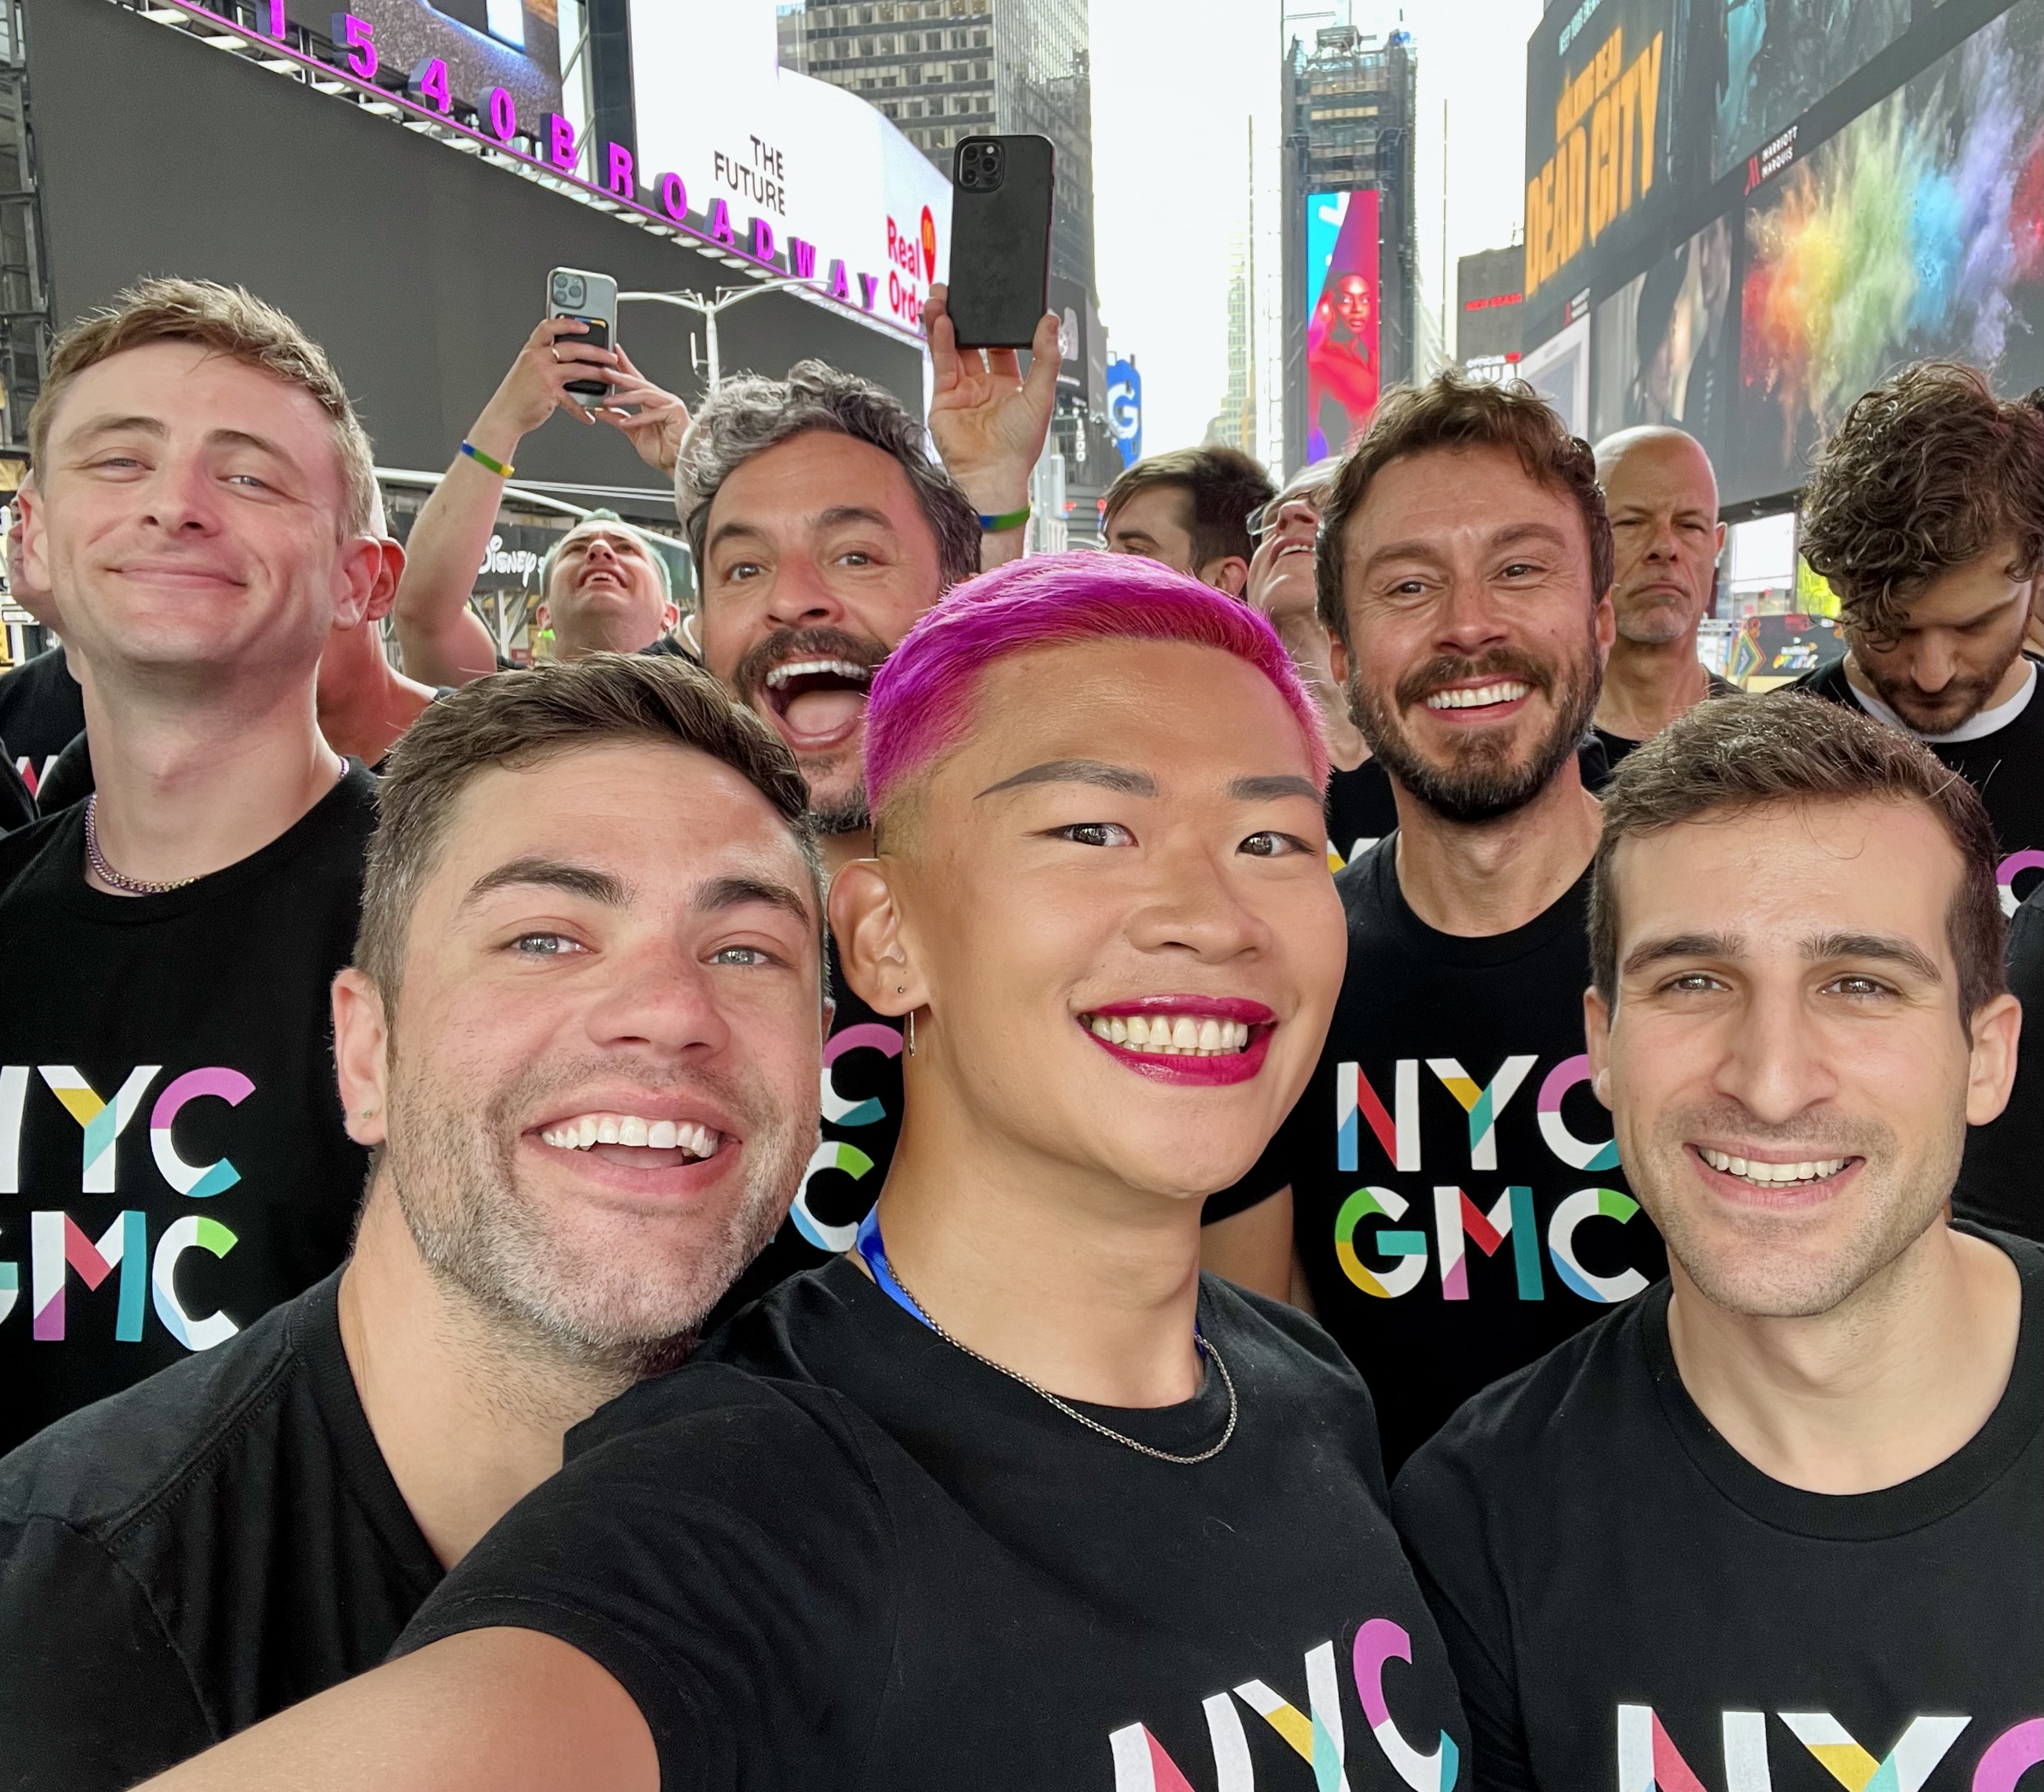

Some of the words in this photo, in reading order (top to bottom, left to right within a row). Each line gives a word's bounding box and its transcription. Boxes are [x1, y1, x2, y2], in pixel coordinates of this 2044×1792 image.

[270, 0, 516, 140] 1540
[551, 113, 879, 312] BROADWAY
[750, 134, 784, 181] THE
[1525, 125, 1587, 300] DEAD
[1589, 30, 1663, 247] CITY
[1761, 146, 1793, 178] MARQUIS
[1762, 125, 1797, 162] MARRIOTT
[714, 150, 786, 216] FUTURE
[887, 215, 921, 281] Real
[1107, 382, 1141, 439] G
[1337, 1054, 1622, 1172] NYC
[1335, 1185, 1650, 1303] GMC
[0, 1210, 240, 1352] MC
